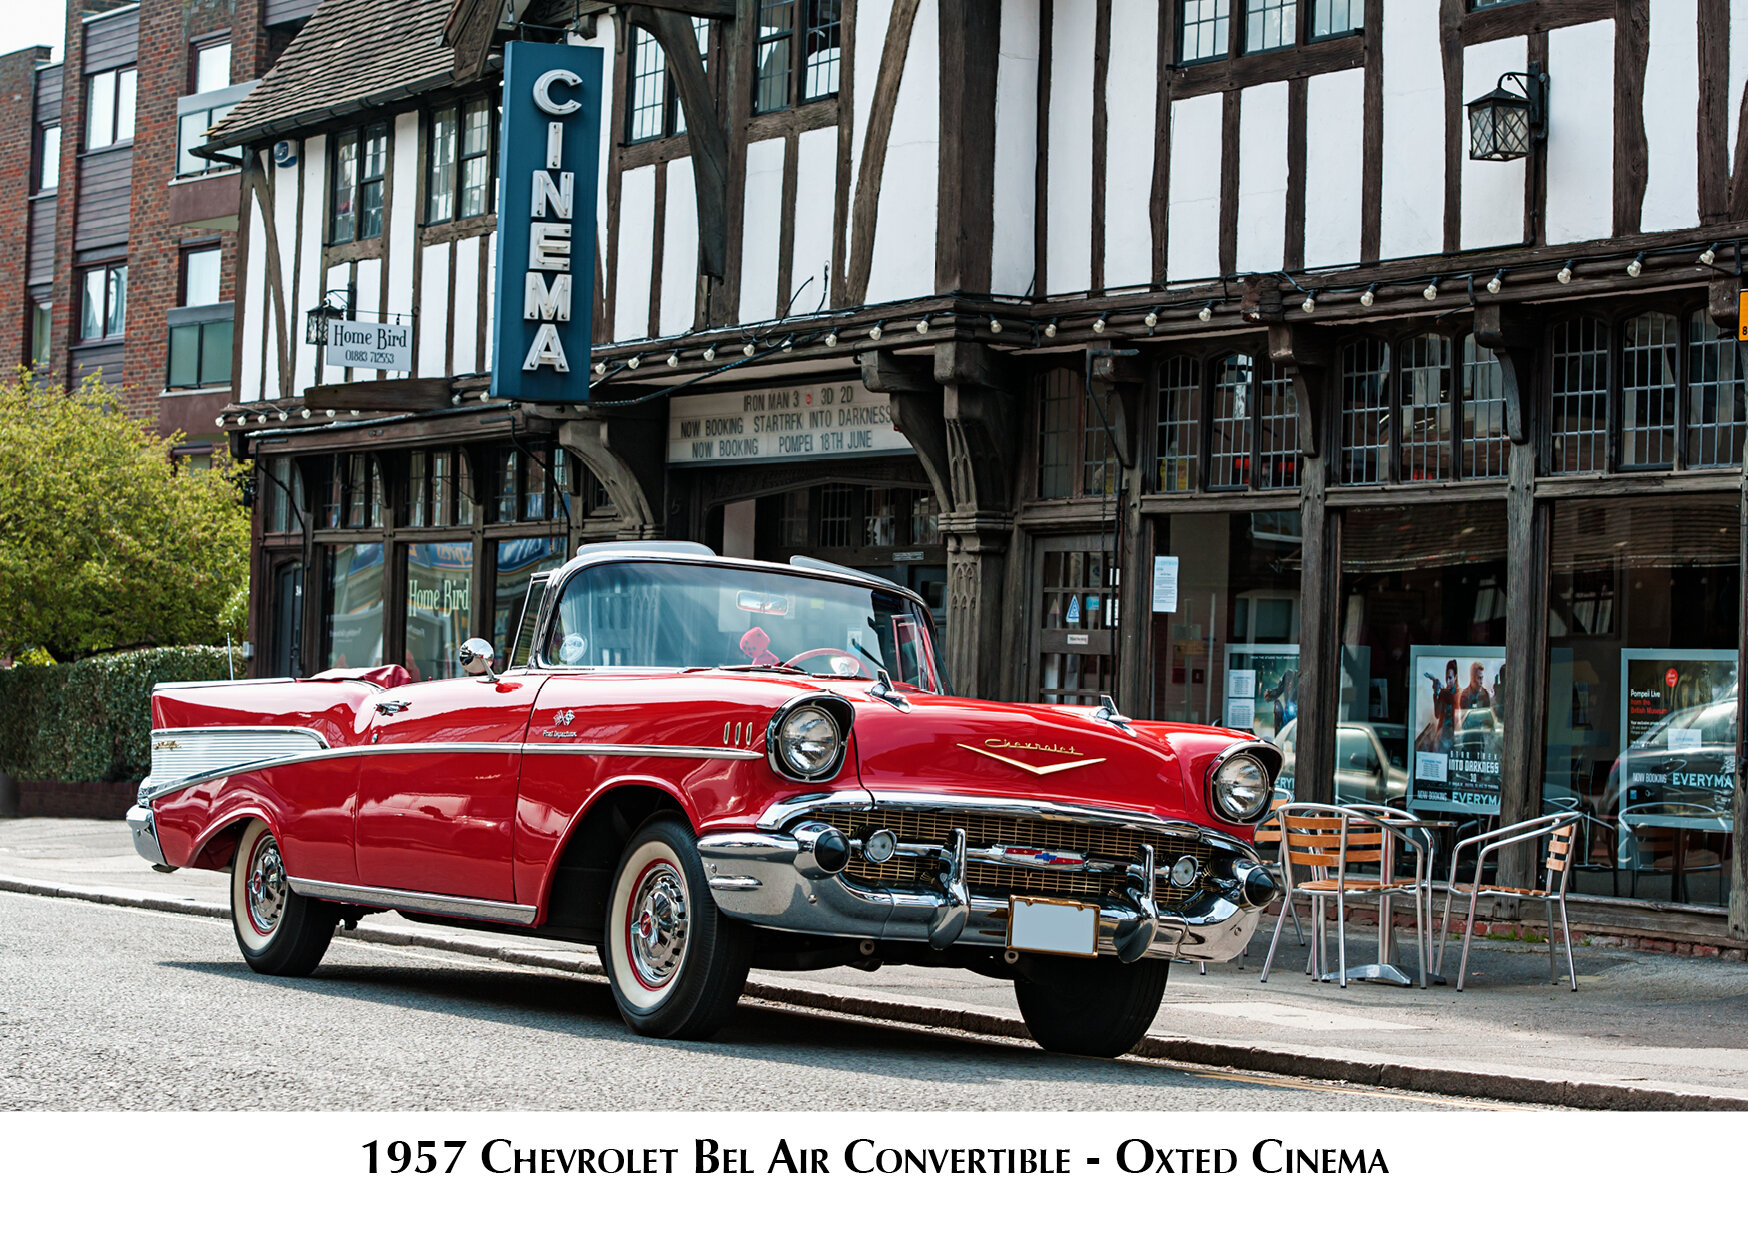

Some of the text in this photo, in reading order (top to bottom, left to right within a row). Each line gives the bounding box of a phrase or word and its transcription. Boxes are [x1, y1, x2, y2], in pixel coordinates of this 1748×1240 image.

[521, 68, 584, 373] CINEMA
[333, 324, 407, 350] Home Bird
[345, 349, 395, 364] 01883 712553
[743, 385, 853, 412] IRON MAN 3 3D 2D
[680, 420, 701, 439] NOW
[705, 416, 744, 437] BOOKING
[809, 409, 832, 429] INTO
[838, 405, 891, 426] DARKNESS
[692, 440, 713, 459] NOW
[719, 438, 759, 457] BOOKING
[820, 431, 843, 451] 18TH
[847, 430, 872, 449] JUNE
[408, 578, 469, 618] Home Bird
[985, 739, 1084, 756] Chevrolet
[1448, 758, 1464, 771] INTO
[1464, 759, 1499, 774] DARKNESS
[1632, 772, 1736, 789] NOW BOOKING EVERYMA
